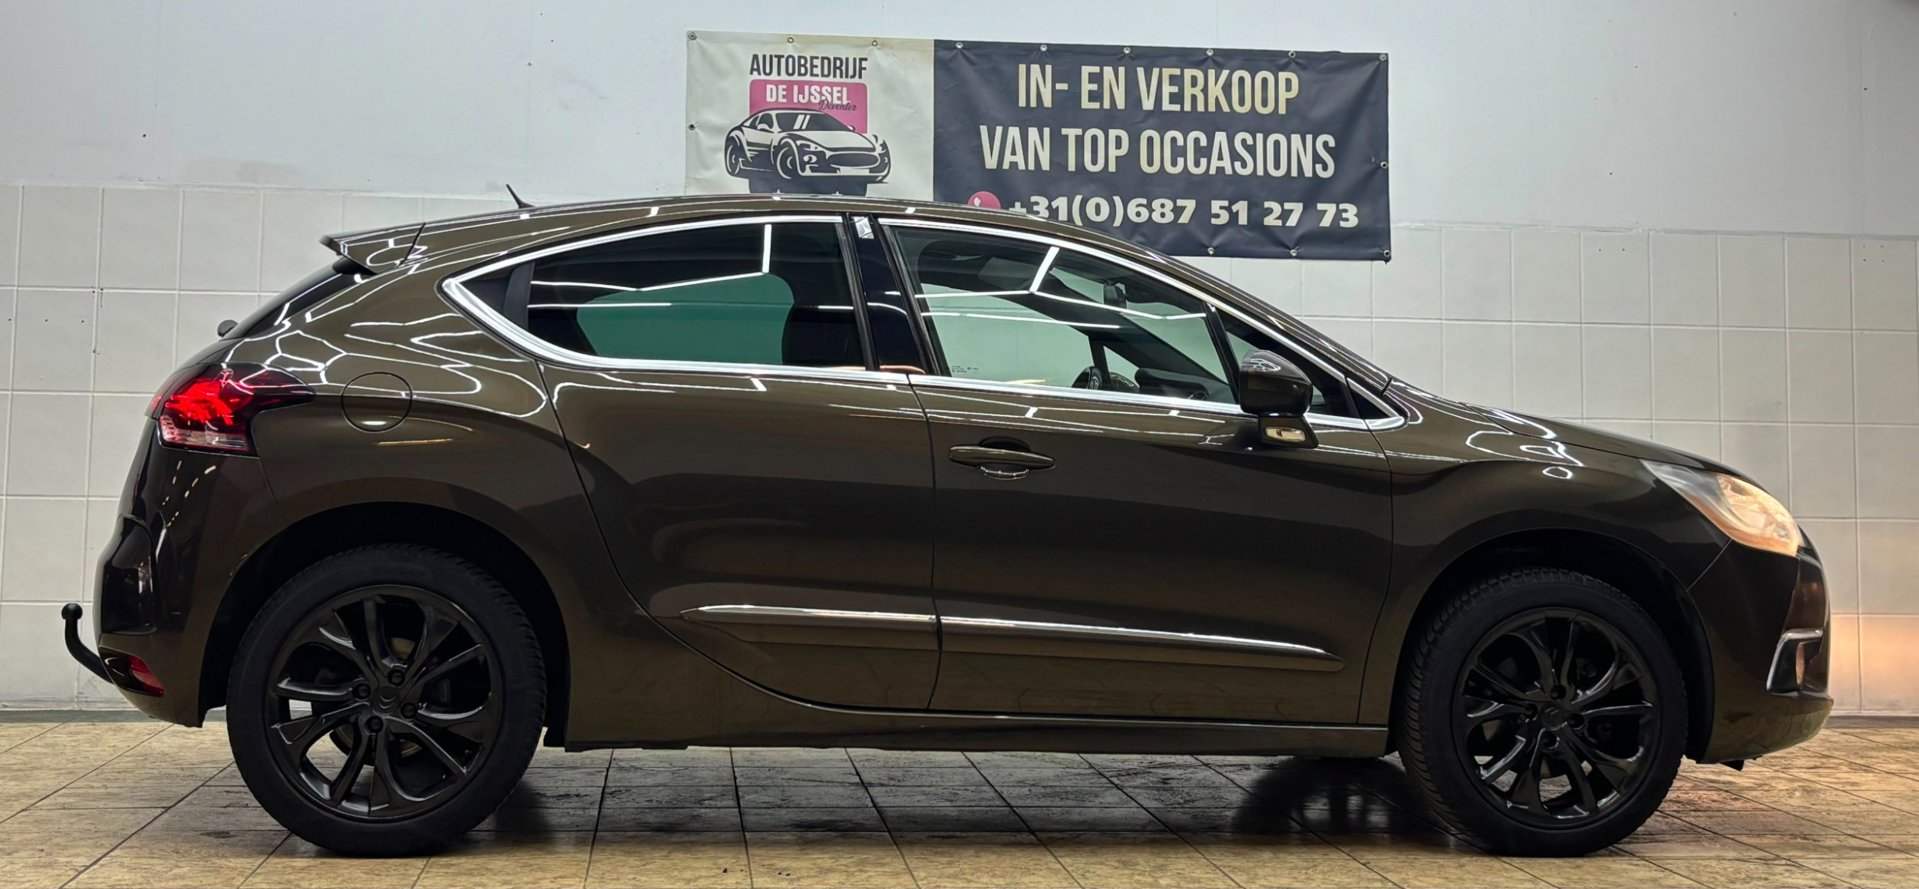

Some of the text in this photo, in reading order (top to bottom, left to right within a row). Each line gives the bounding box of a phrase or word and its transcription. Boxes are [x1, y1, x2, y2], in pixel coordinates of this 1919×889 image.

[750, 54, 868, 79] AUTOBEDRIJF
[765, 84, 850, 105] DE IJSSEL
[1017, 64, 1300, 115] IN- EN VERKOOP
[979, 124, 1336, 178] VAN TOP OCCASIONS
[1210, 200, 1249, 226] 51
[1263, 201, 1303, 227] 27
[1318, 203, 1360, 229] 73
